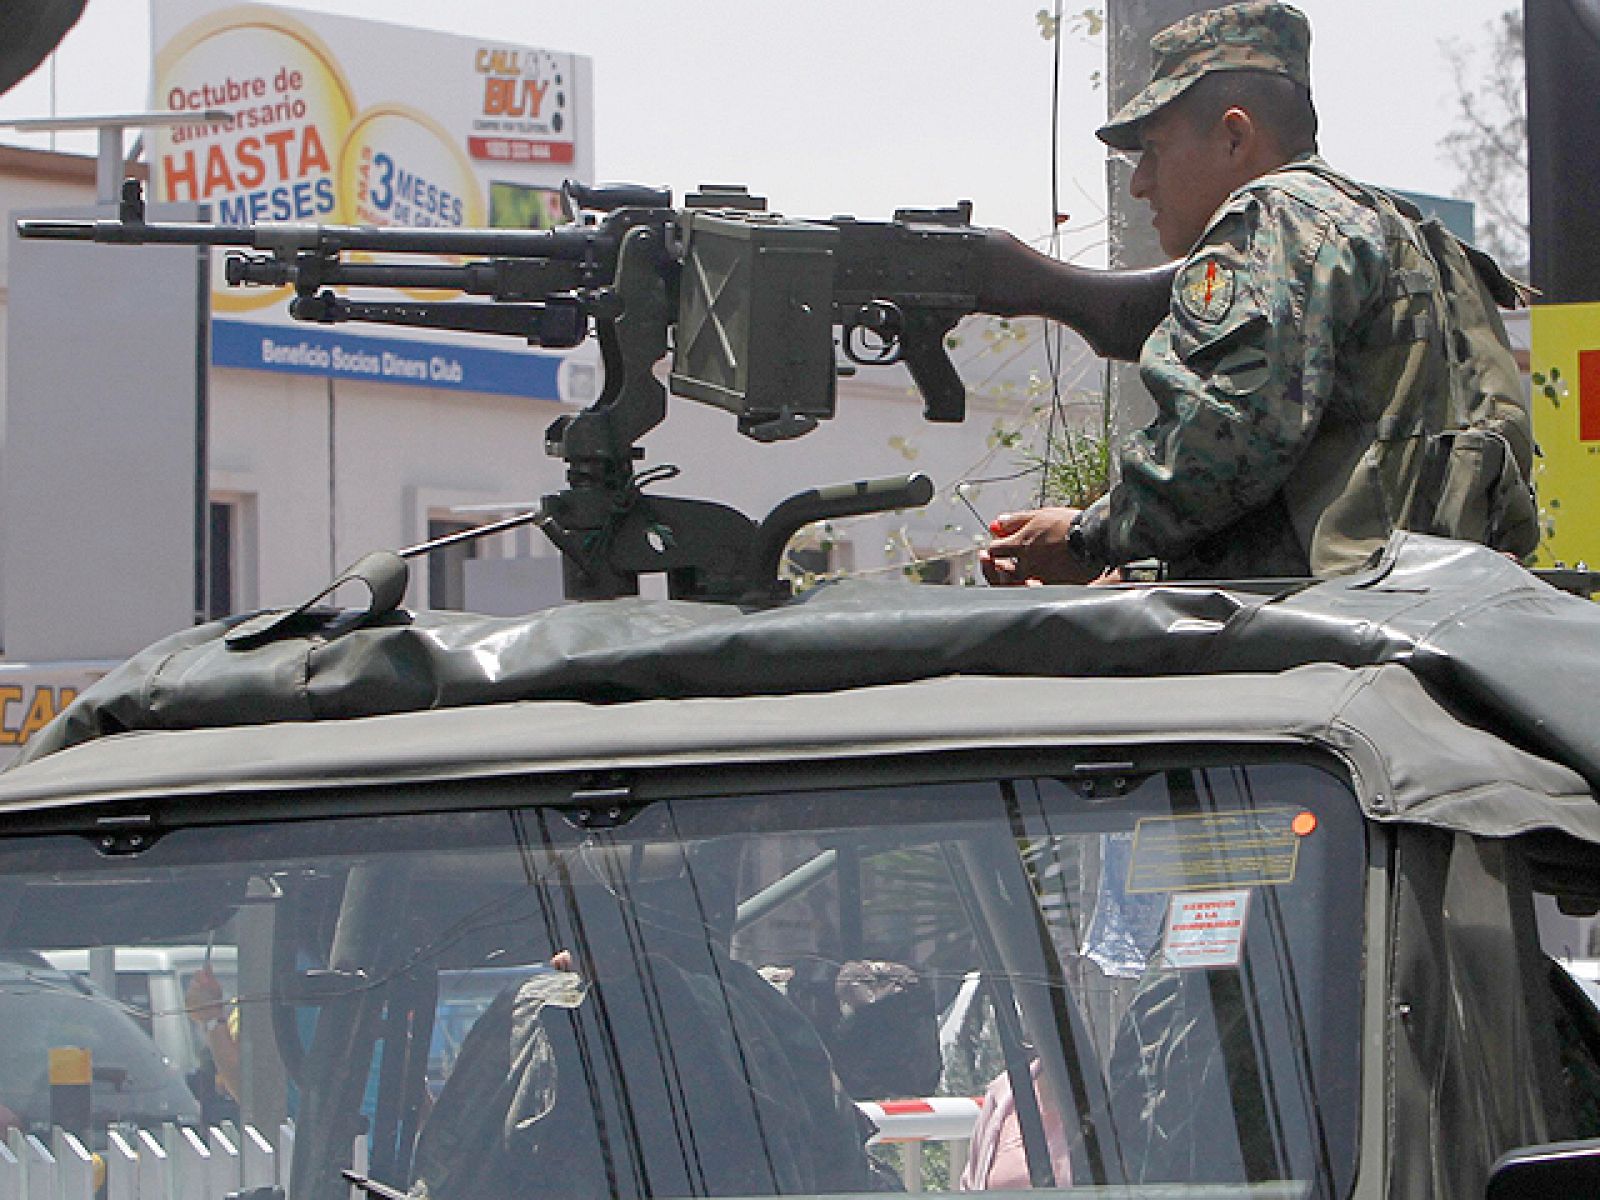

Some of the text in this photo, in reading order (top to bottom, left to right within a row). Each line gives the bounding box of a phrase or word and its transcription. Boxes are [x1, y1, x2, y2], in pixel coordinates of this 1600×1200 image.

[168, 66, 303, 111] Octubre de
[483, 78, 549, 118] BUY
[163, 124, 331, 202] HASTA
[219, 179, 336, 225] MESES
[370, 152, 463, 226] 3 MESES
[261, 338, 463, 384] Beneficio Socios Diners Club
